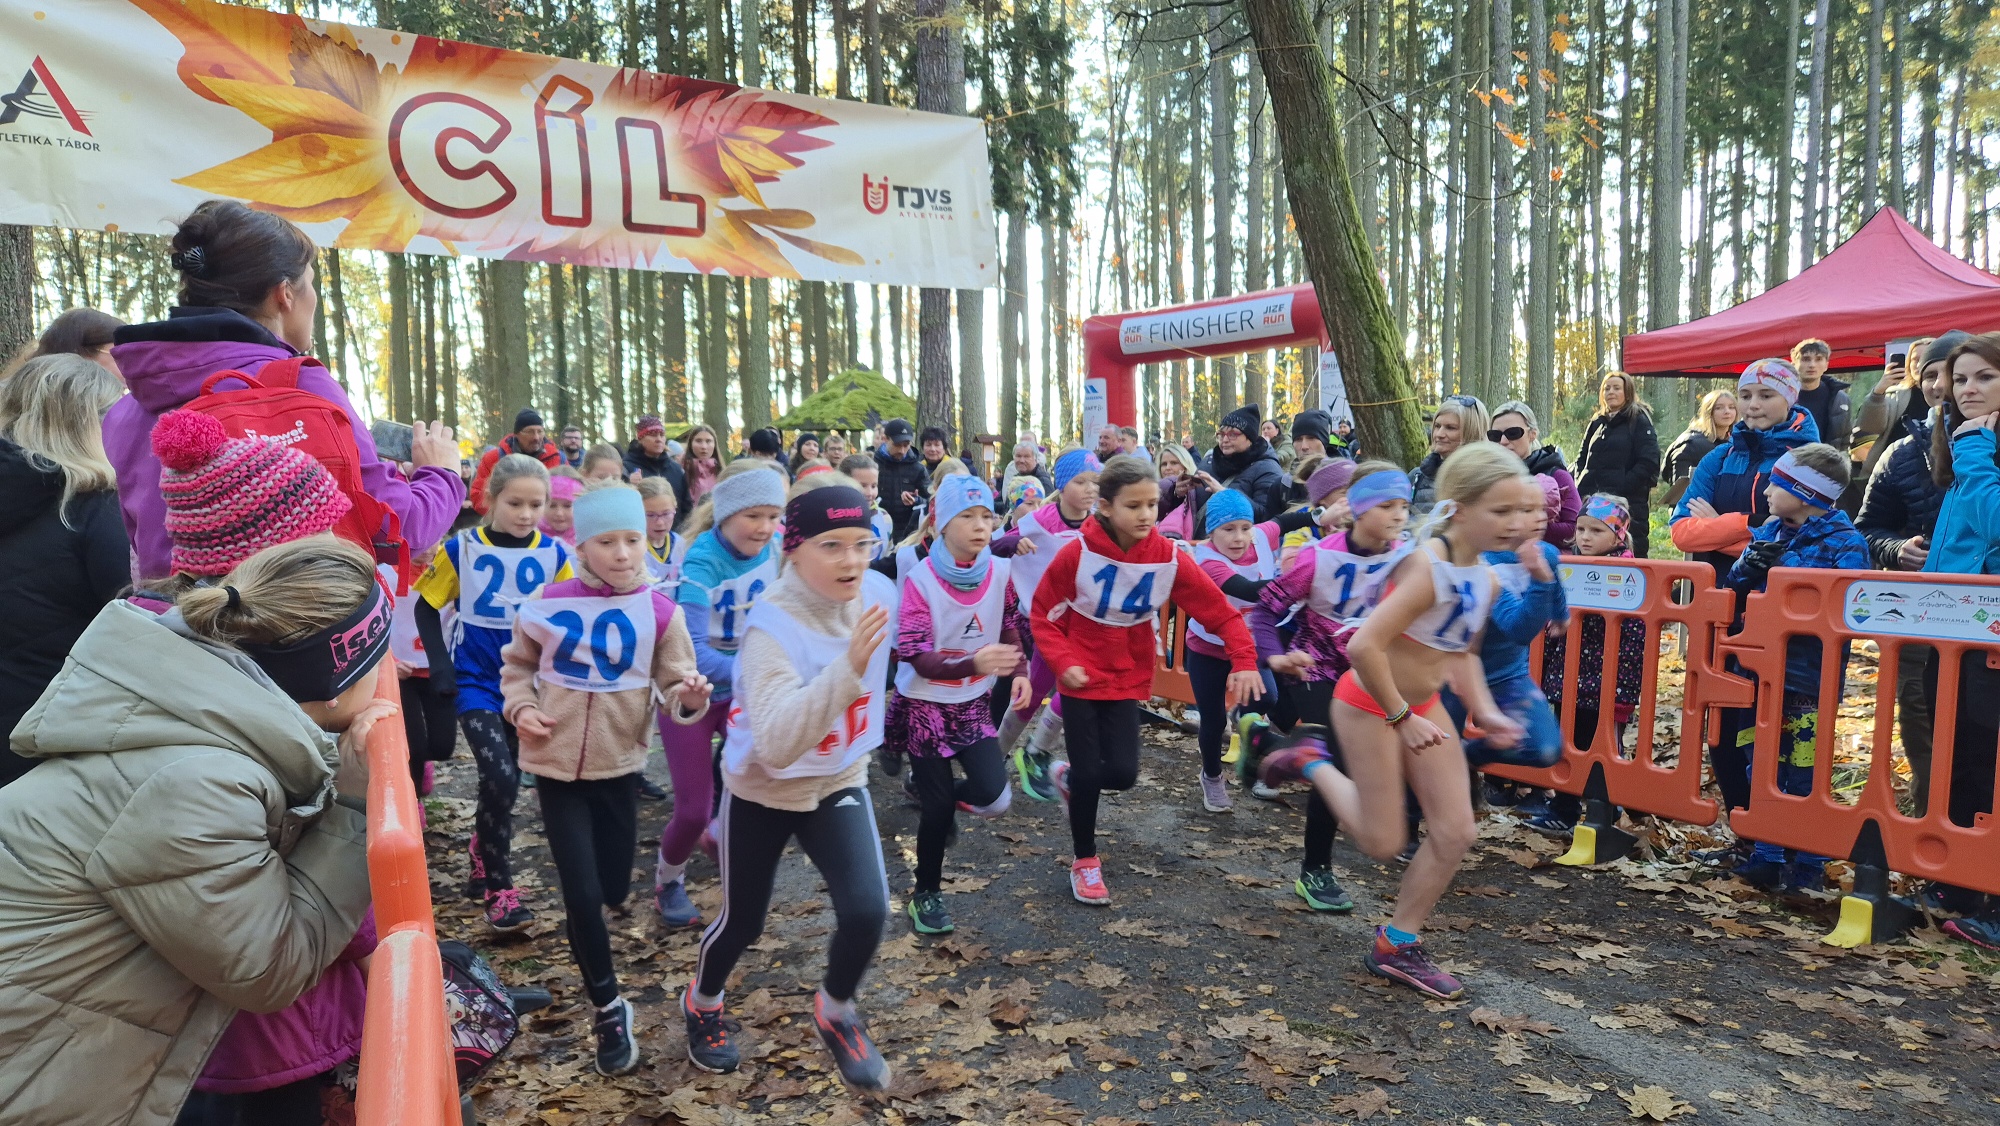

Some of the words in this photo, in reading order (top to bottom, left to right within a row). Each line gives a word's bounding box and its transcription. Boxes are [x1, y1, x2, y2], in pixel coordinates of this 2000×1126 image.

[56, 137, 101, 152] TÁBOR
[388, 74, 706, 238] CÍL
[899, 211, 954, 221] ATLETIKA
[1150, 309, 1255, 343] FINISHER
[473, 553, 545, 618] 29
[1093, 564, 1155, 620] 14
[1978, 595, 2000, 603] Triat
[545, 608, 636, 681] 20
